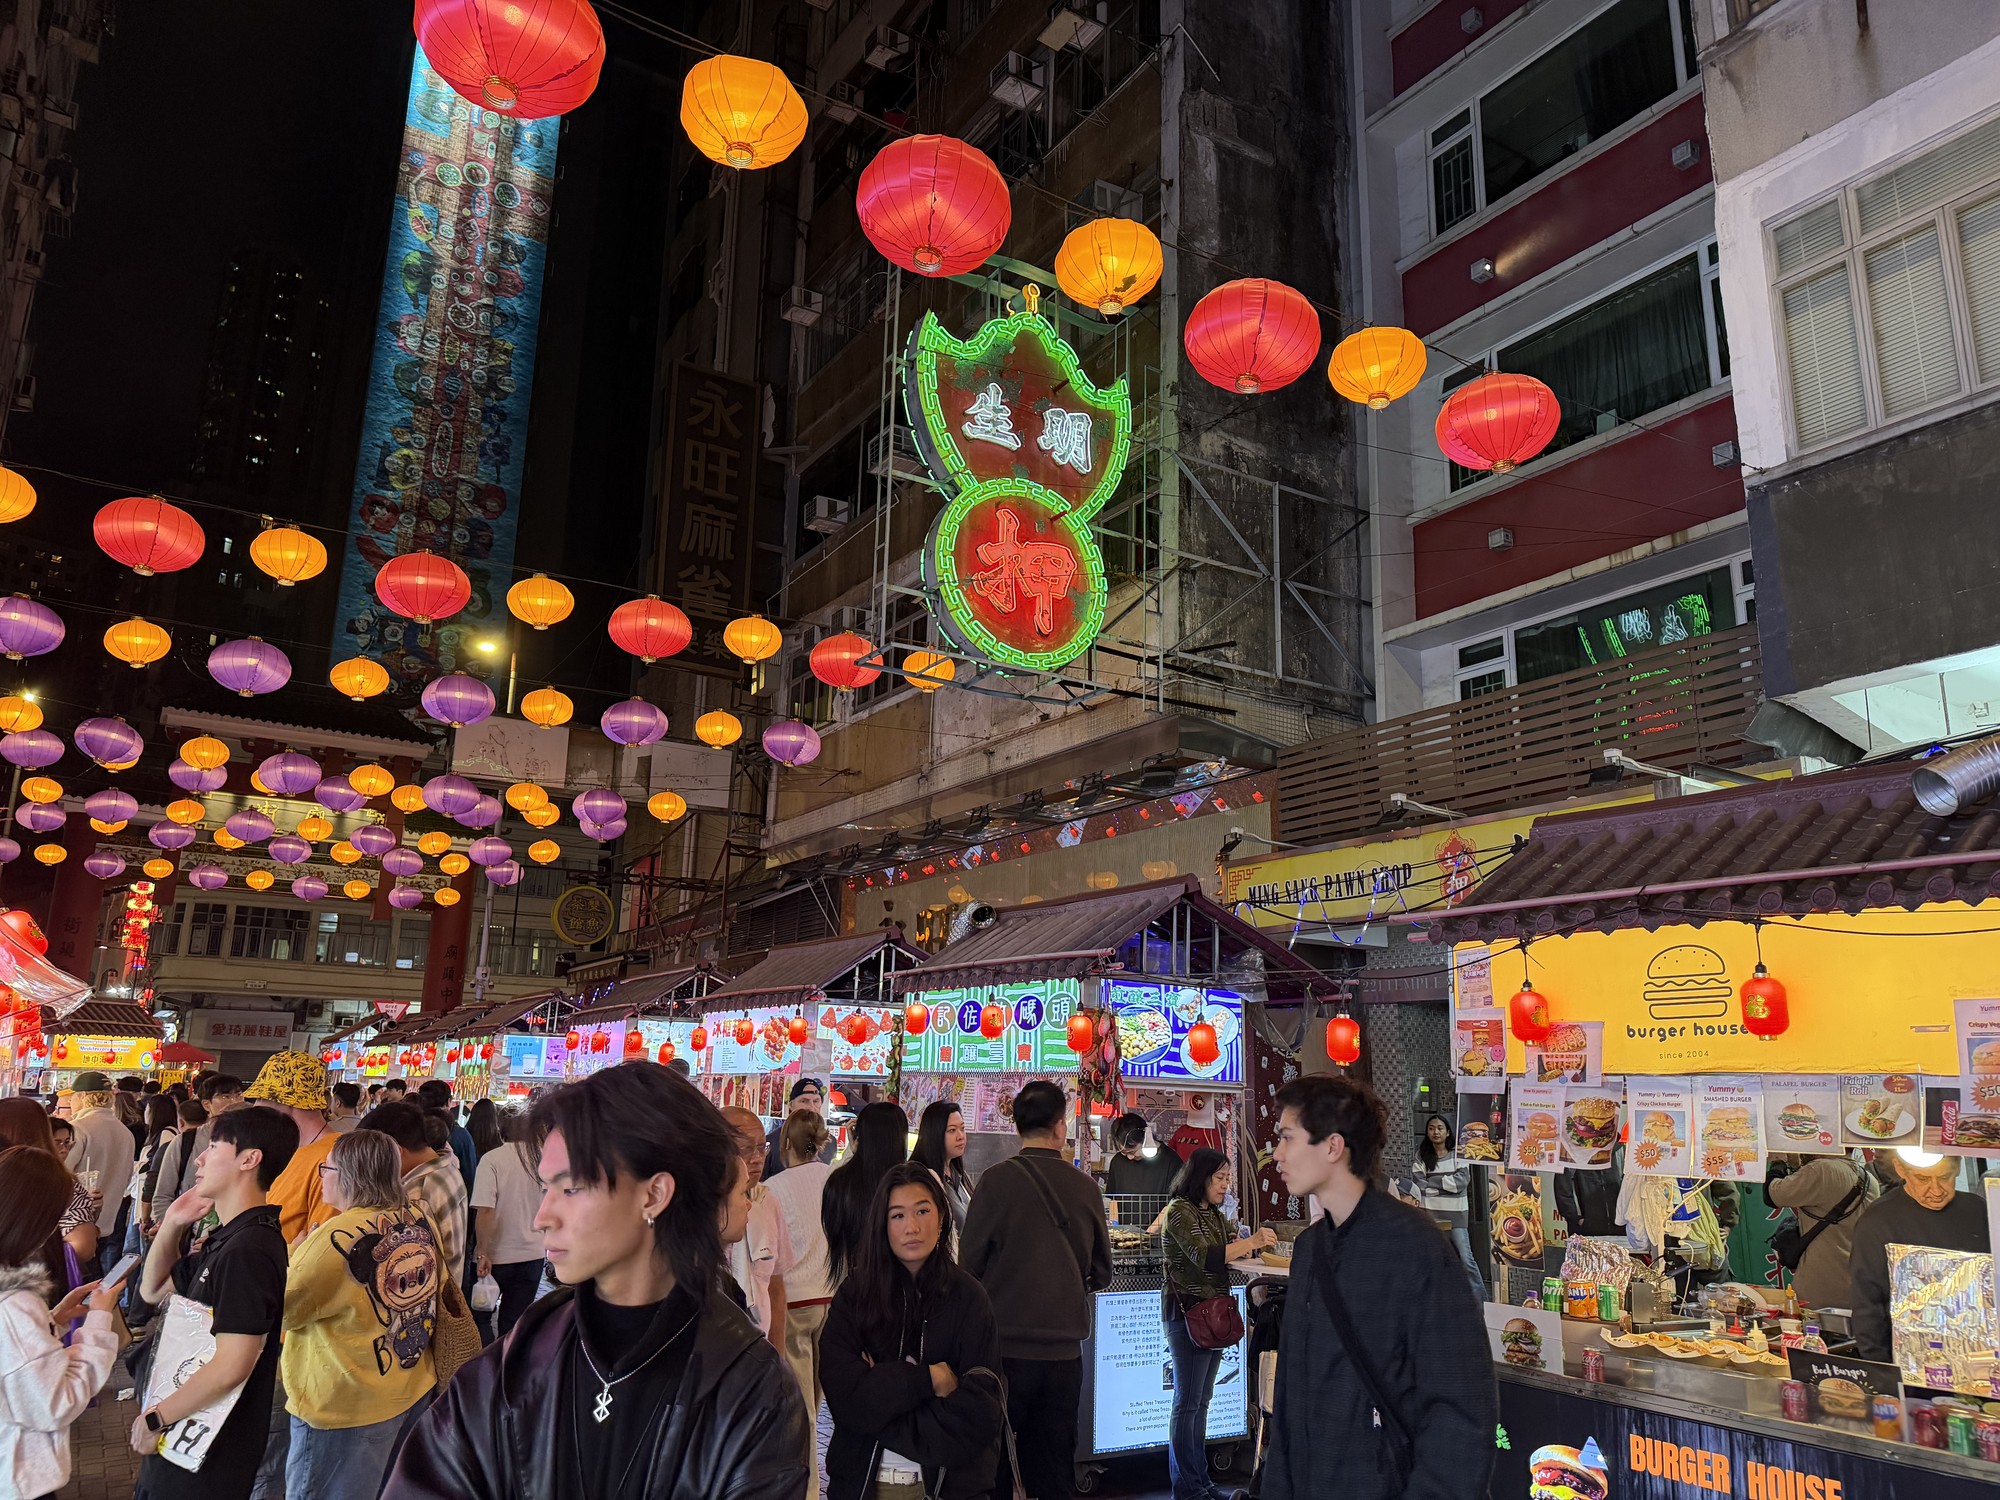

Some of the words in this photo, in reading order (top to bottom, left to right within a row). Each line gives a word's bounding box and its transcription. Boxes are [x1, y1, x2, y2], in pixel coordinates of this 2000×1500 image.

[677, 379, 744, 624] 永旺麻雀
[973, 508, 1077, 636] 押
[1248, 884, 1279, 908] MING
[1285, 877, 1318, 902] SANG
[1324, 870, 1365, 899] PAWN
[1371, 863, 1412, 893] SHOP
[1627, 1025, 1686, 1042] burger
[1694, 1023, 1749, 1036] house
[1659, 1051, 1683, 1060] since
[1687, 1050, 1709, 1058] 2004
[1771, 1080, 1798, 1088] FALAFEL
[1844, 1076, 1874, 1086] Falafel
[1708, 1085, 1736, 1094] Yummy
[1850, 1086, 1868, 1095] Roll
[1523, 1145, 1537, 1155] $50
[1640, 1148, 1656, 1159] $50
[1706, 1155, 1724, 1167] $55
[1811, 1363, 1832, 1377] Beef
[1834, 1364, 1868, 1380] Burger
[1629, 1433, 1731, 1494] BURGER
[1747, 1460, 1842, 1500] HOUSE
